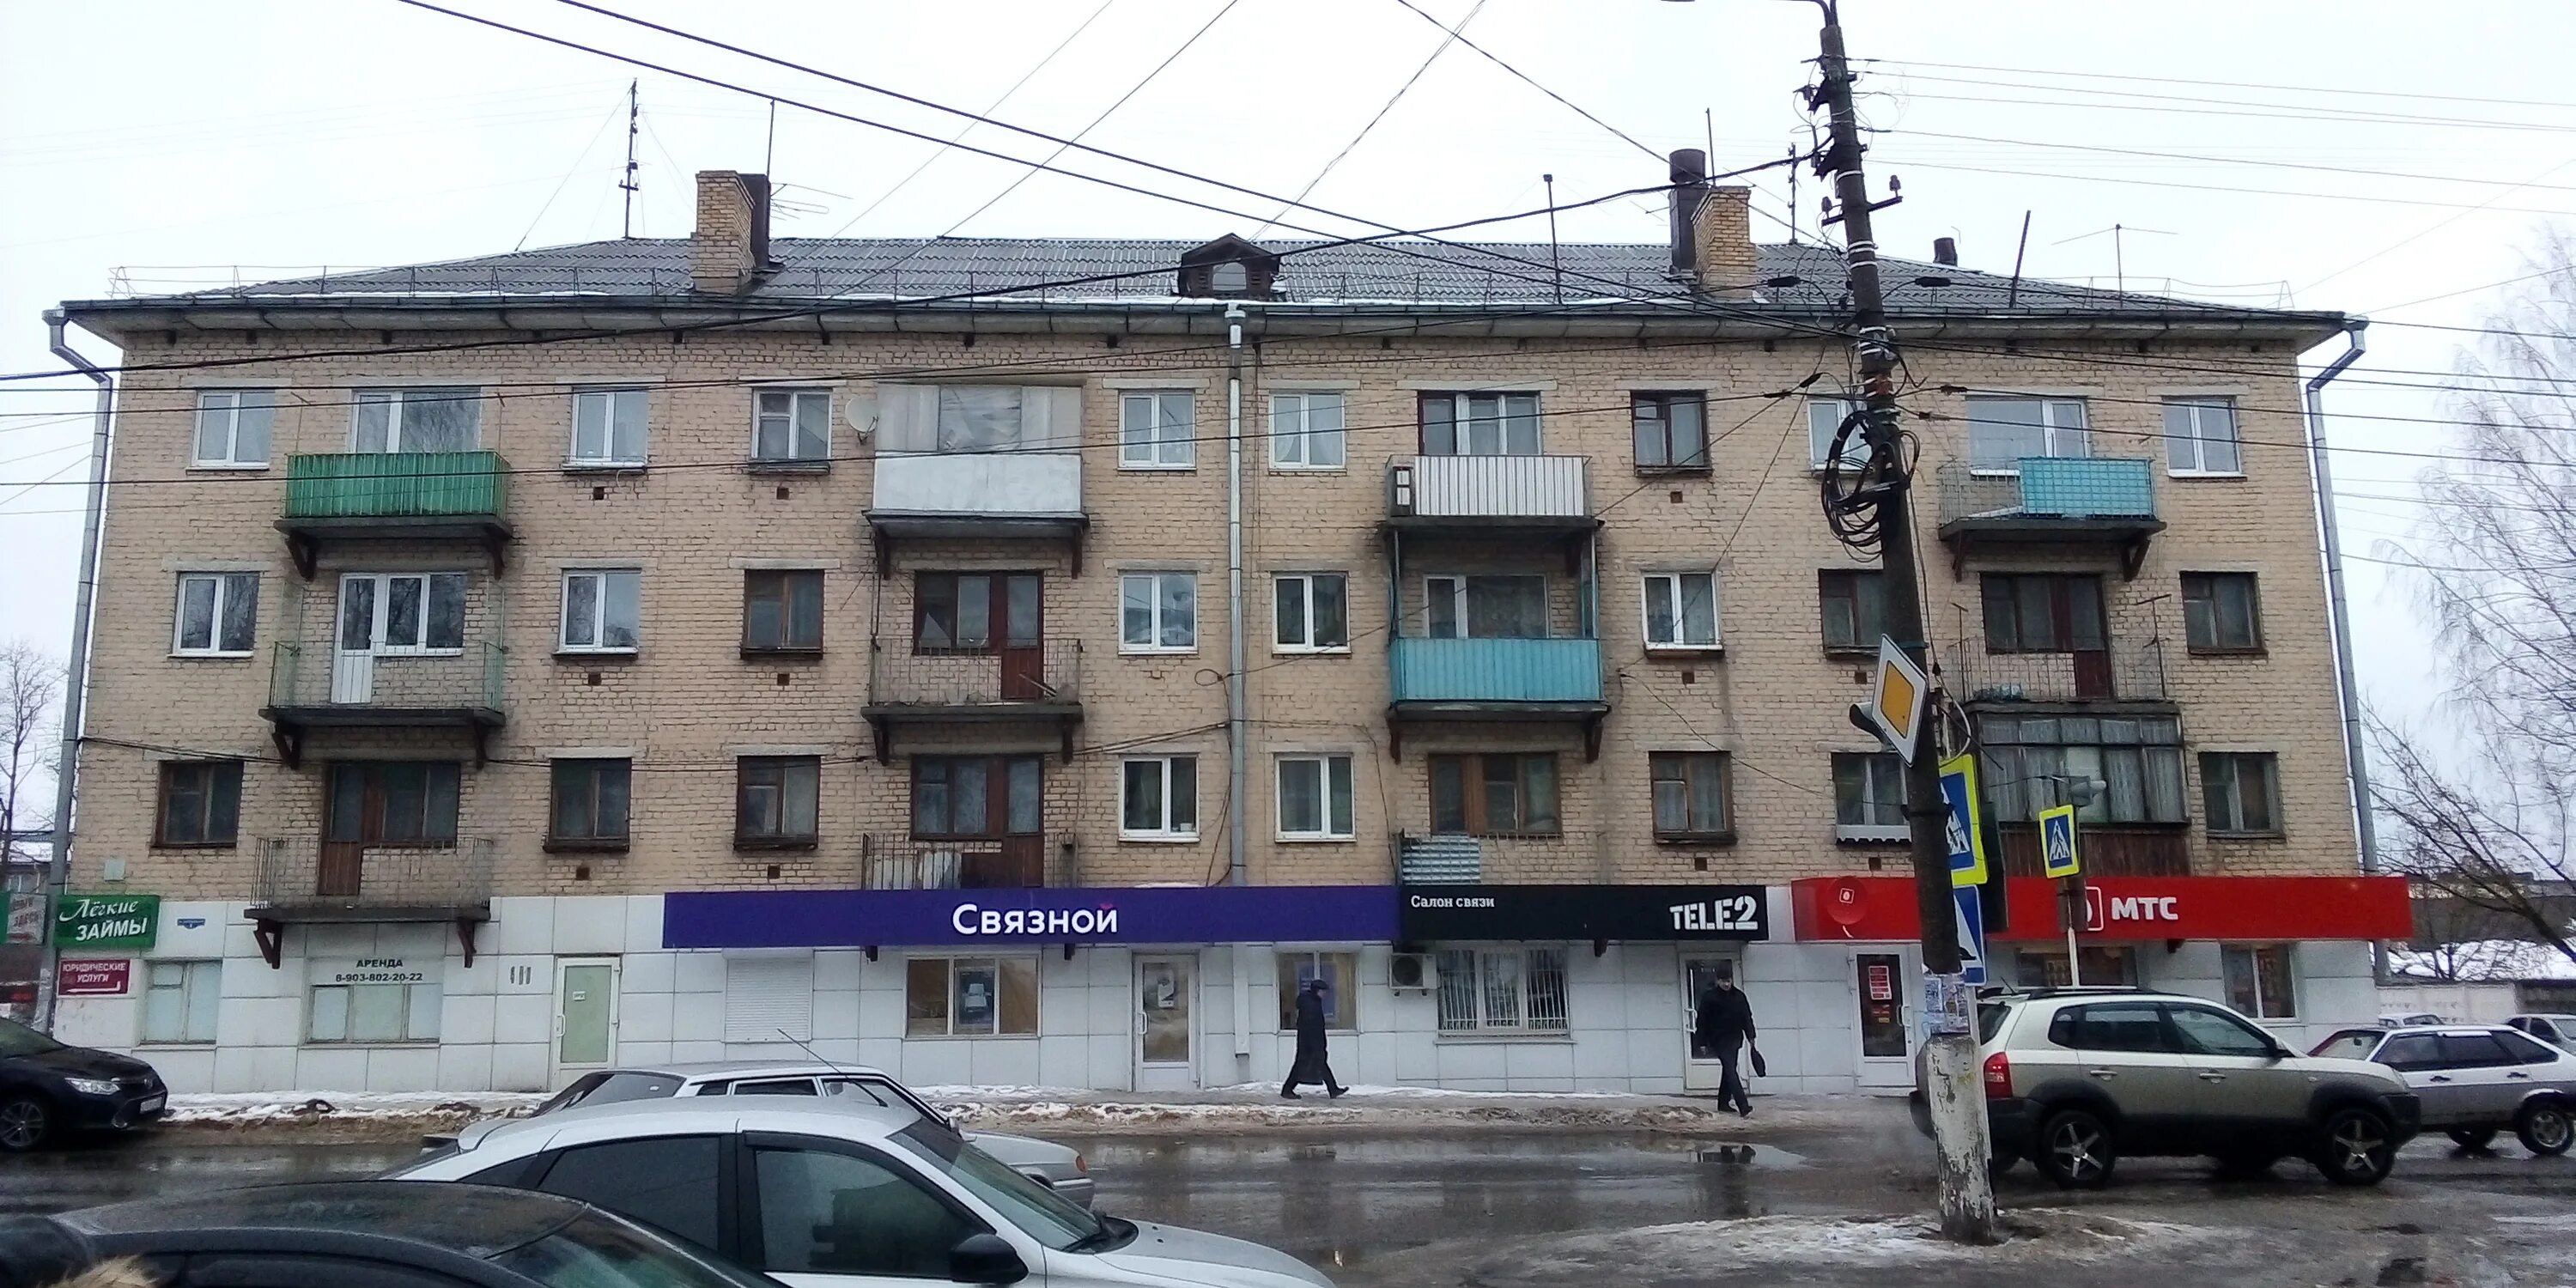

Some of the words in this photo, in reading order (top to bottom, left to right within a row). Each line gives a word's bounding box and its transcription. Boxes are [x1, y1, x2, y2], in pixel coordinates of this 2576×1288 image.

[58, 898, 139, 922] Лёгкие
[1411, 895, 1454, 908] Салон
[1455, 897, 1495, 908] связи
[2111, 896, 2178, 920] МТС
[952, 903, 1118, 935] Связной
[1669, 895, 1759, 931] TELE2
[76, 917, 148, 941] ЗАЙМЫ
[63, 963, 126, 972] ЮРИДИЧЕСКИЕ
[355, 958, 404, 969] АРЕНДА
[76, 974, 110, 983] УСЛУГИ
[336, 973, 423, 982] 8-903-802-20-22
